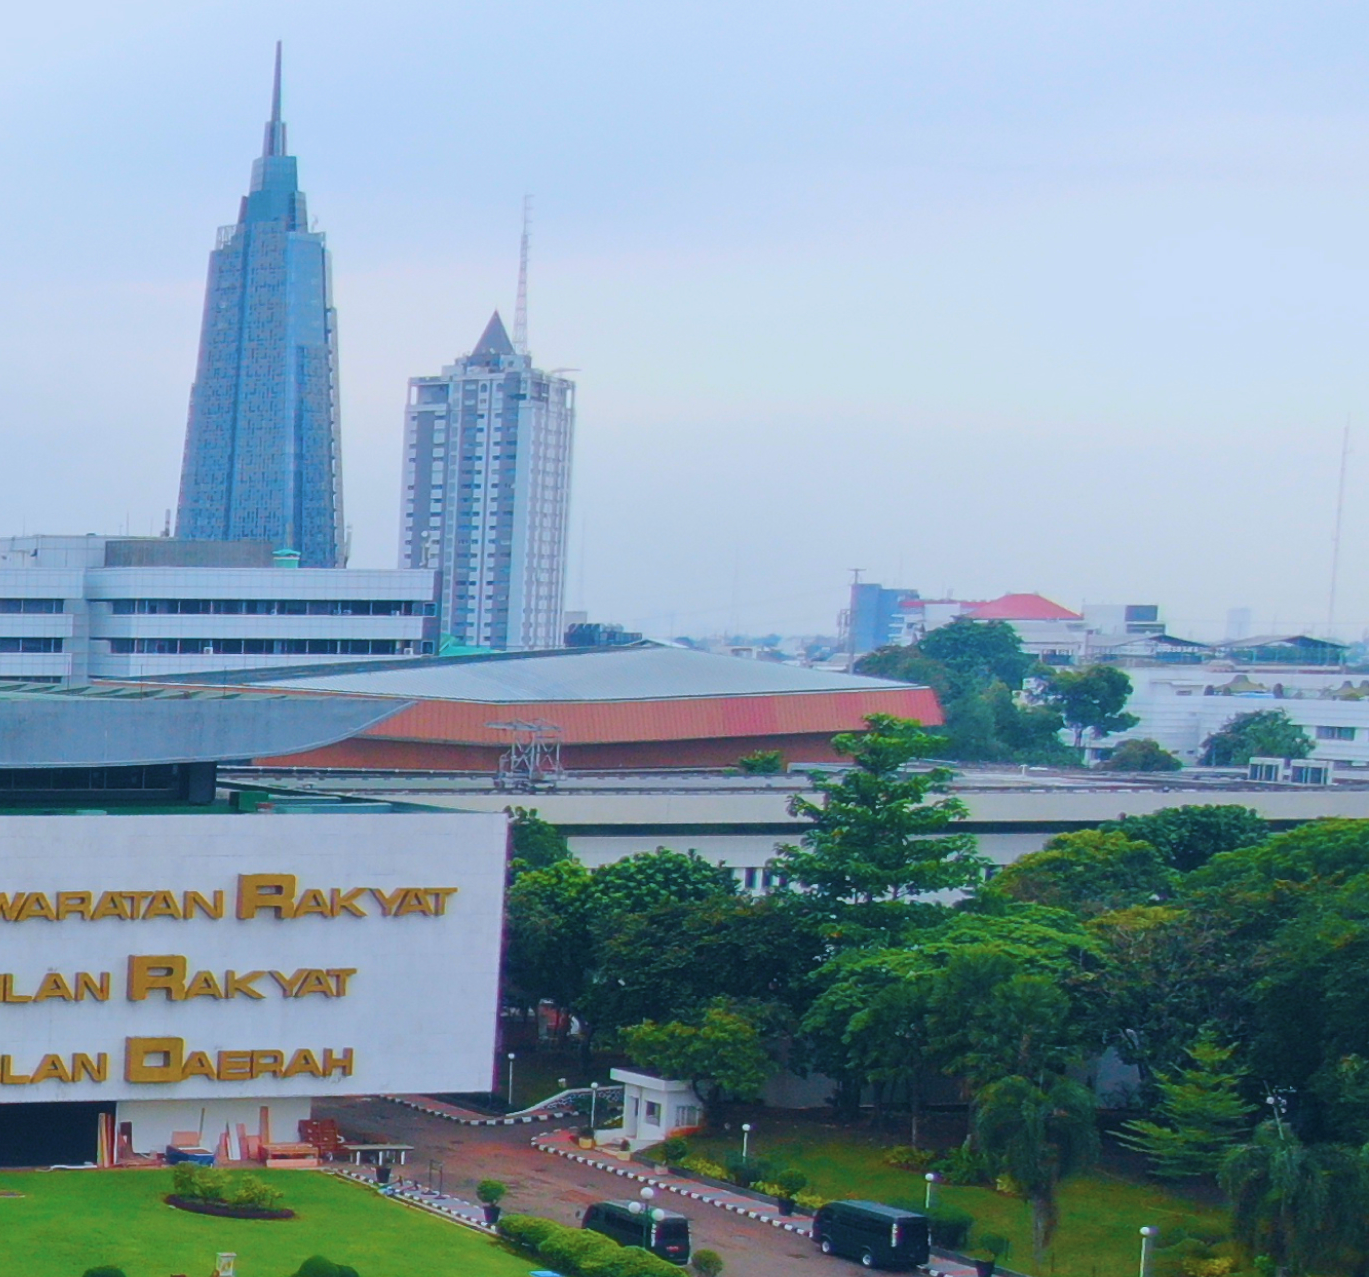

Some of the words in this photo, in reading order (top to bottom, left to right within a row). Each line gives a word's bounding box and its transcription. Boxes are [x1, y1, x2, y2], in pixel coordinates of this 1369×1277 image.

[237, 873, 459, 920] RAKYAT
[127, 954, 358, 1001] RAKYAT
[124, 1036, 355, 1084] DAERAH
